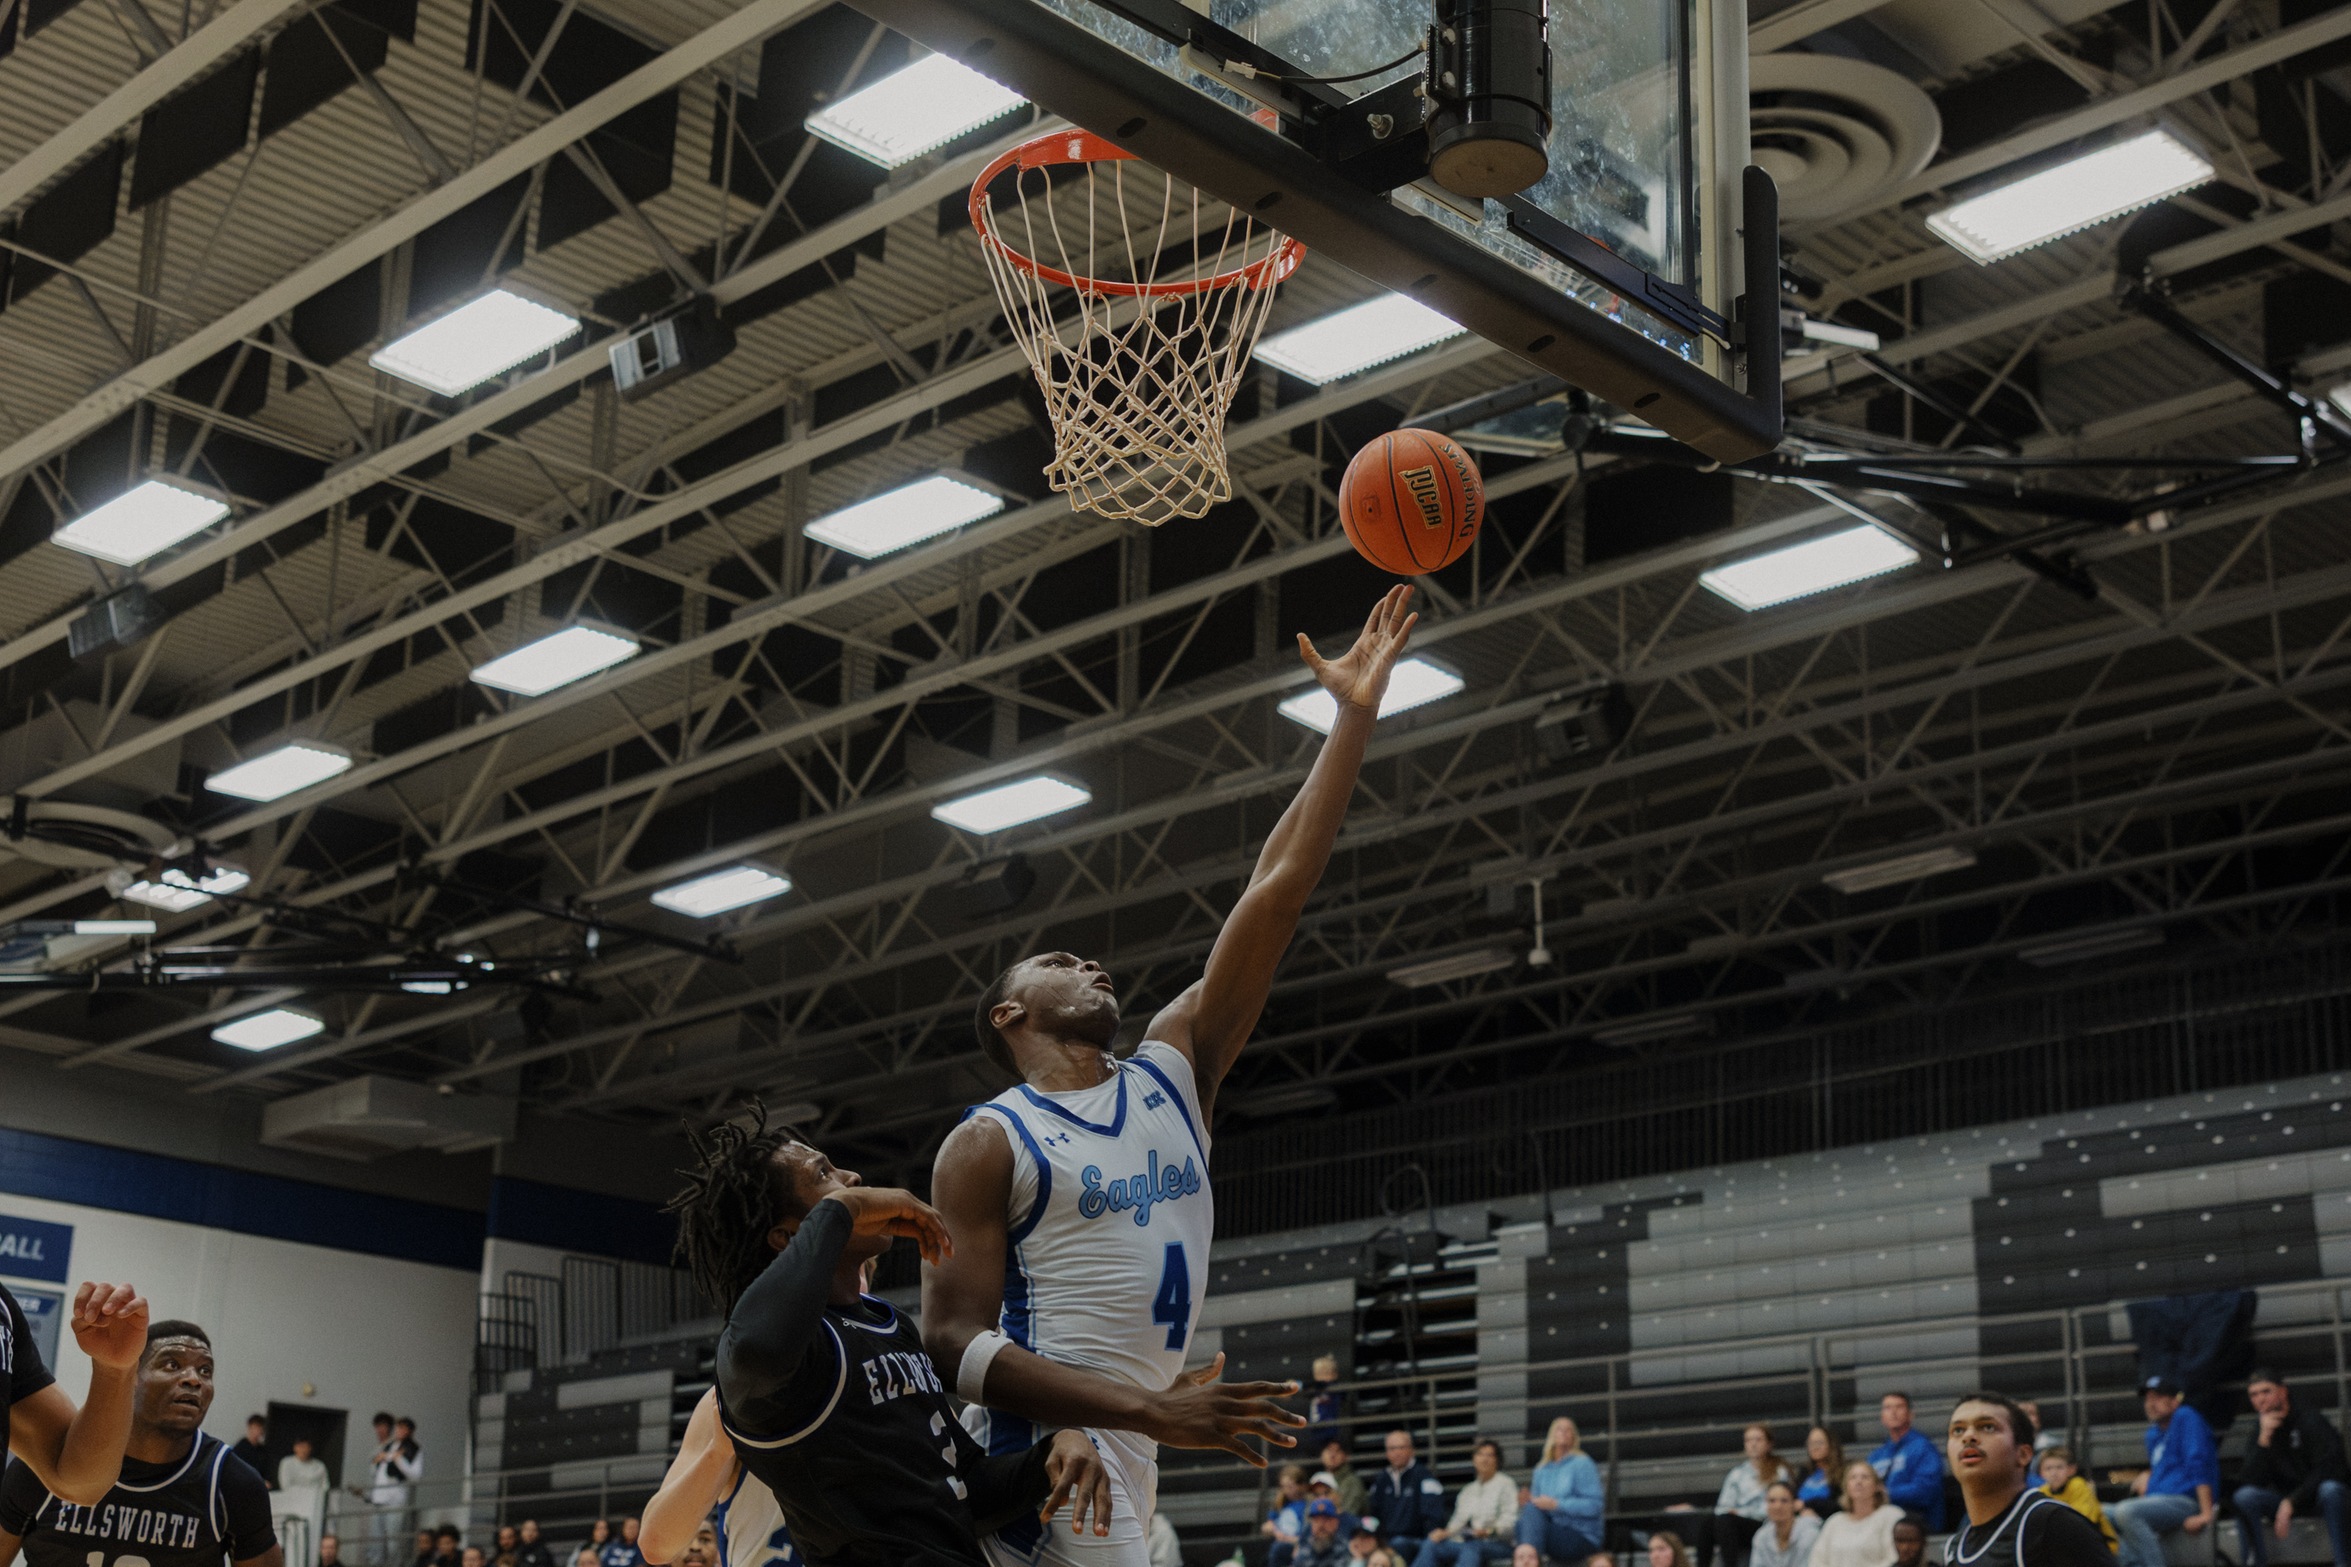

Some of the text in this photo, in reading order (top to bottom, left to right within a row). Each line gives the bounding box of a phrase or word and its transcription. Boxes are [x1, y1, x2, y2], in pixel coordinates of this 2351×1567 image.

[1402, 466, 1443, 527] NJCAA
[1439, 443, 1476, 538] SPALDING
[1079, 1150, 1200, 1226] Eagles
[0, 1232, 45, 1262] ALL
[1152, 1241, 1191, 1353] 4
[54, 1500, 200, 1549] ELLSWORTH
